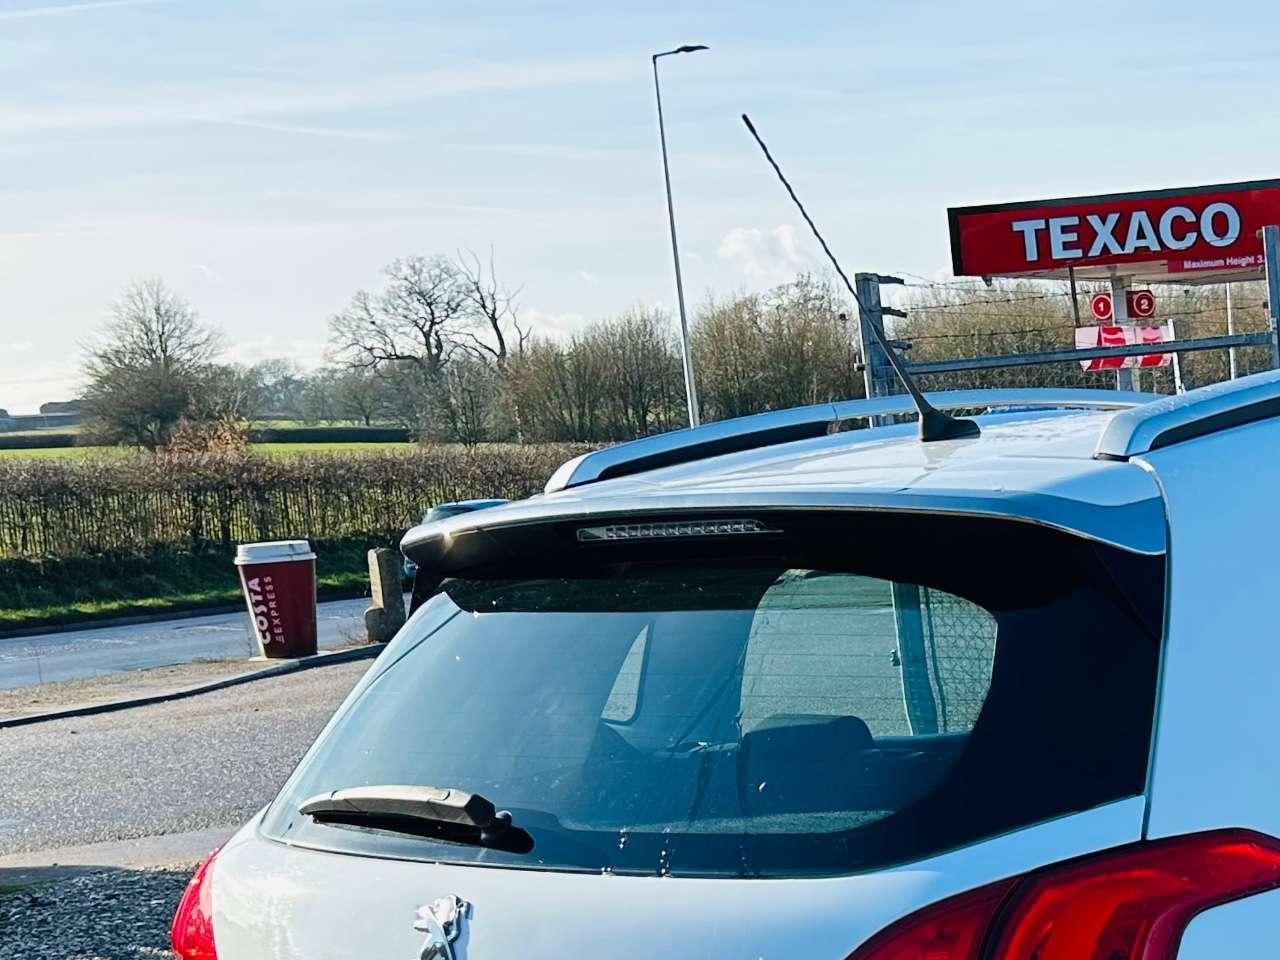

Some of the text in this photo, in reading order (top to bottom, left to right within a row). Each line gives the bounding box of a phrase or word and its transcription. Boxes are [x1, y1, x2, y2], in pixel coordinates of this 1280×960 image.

[1012, 202, 1241, 262] TEXACO
[1183, 259, 1225, 269] Maximum
[1226, 255, 1255, 267] Height
[1098, 301, 1104, 311] 1
[1140, 299, 1149, 310] 2
[248, 577, 271, 645] COSTA
[264, 576, 283, 634] EXPRESS
